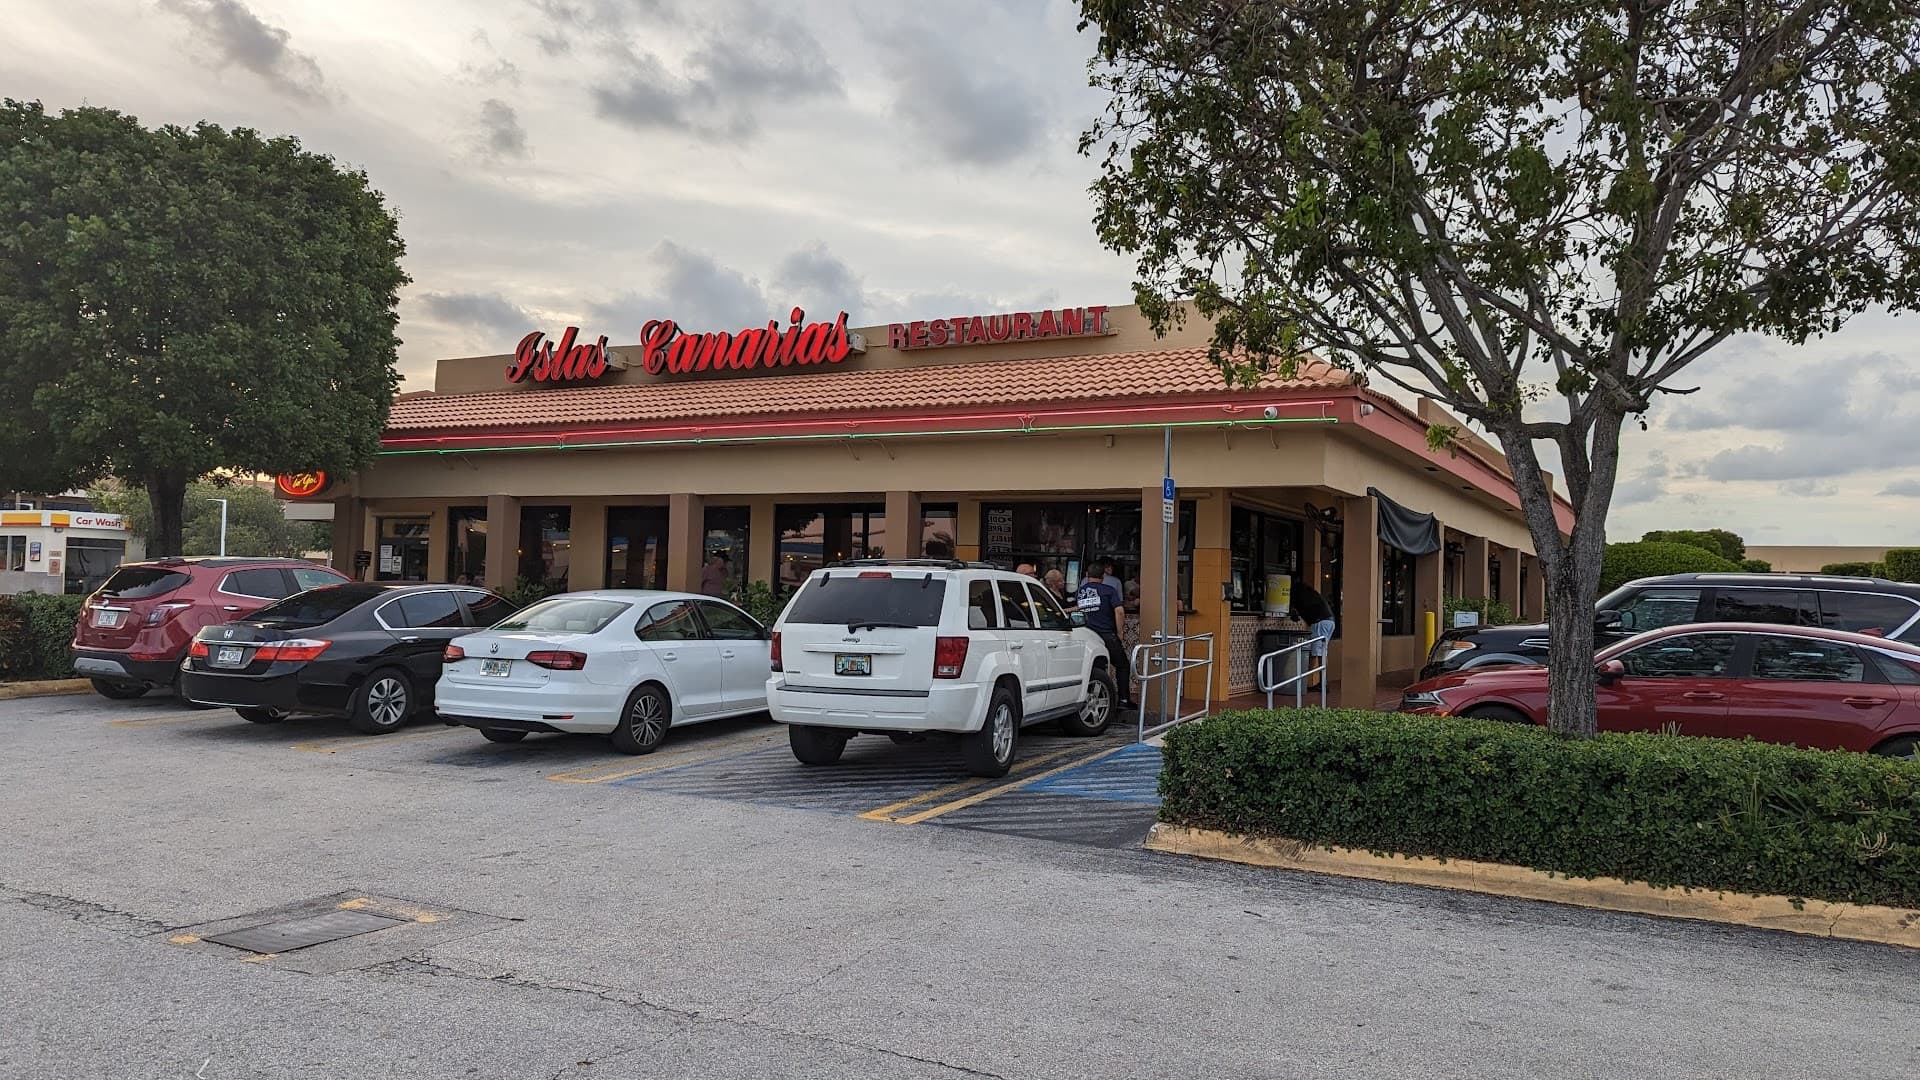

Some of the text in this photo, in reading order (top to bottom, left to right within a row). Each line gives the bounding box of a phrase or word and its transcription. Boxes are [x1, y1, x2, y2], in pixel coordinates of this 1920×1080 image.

[505, 306, 849, 383] Islas Canarias
[888, 305, 1109, 349] RESTAURANT
[75, 516, 121, 527] Car Wash
